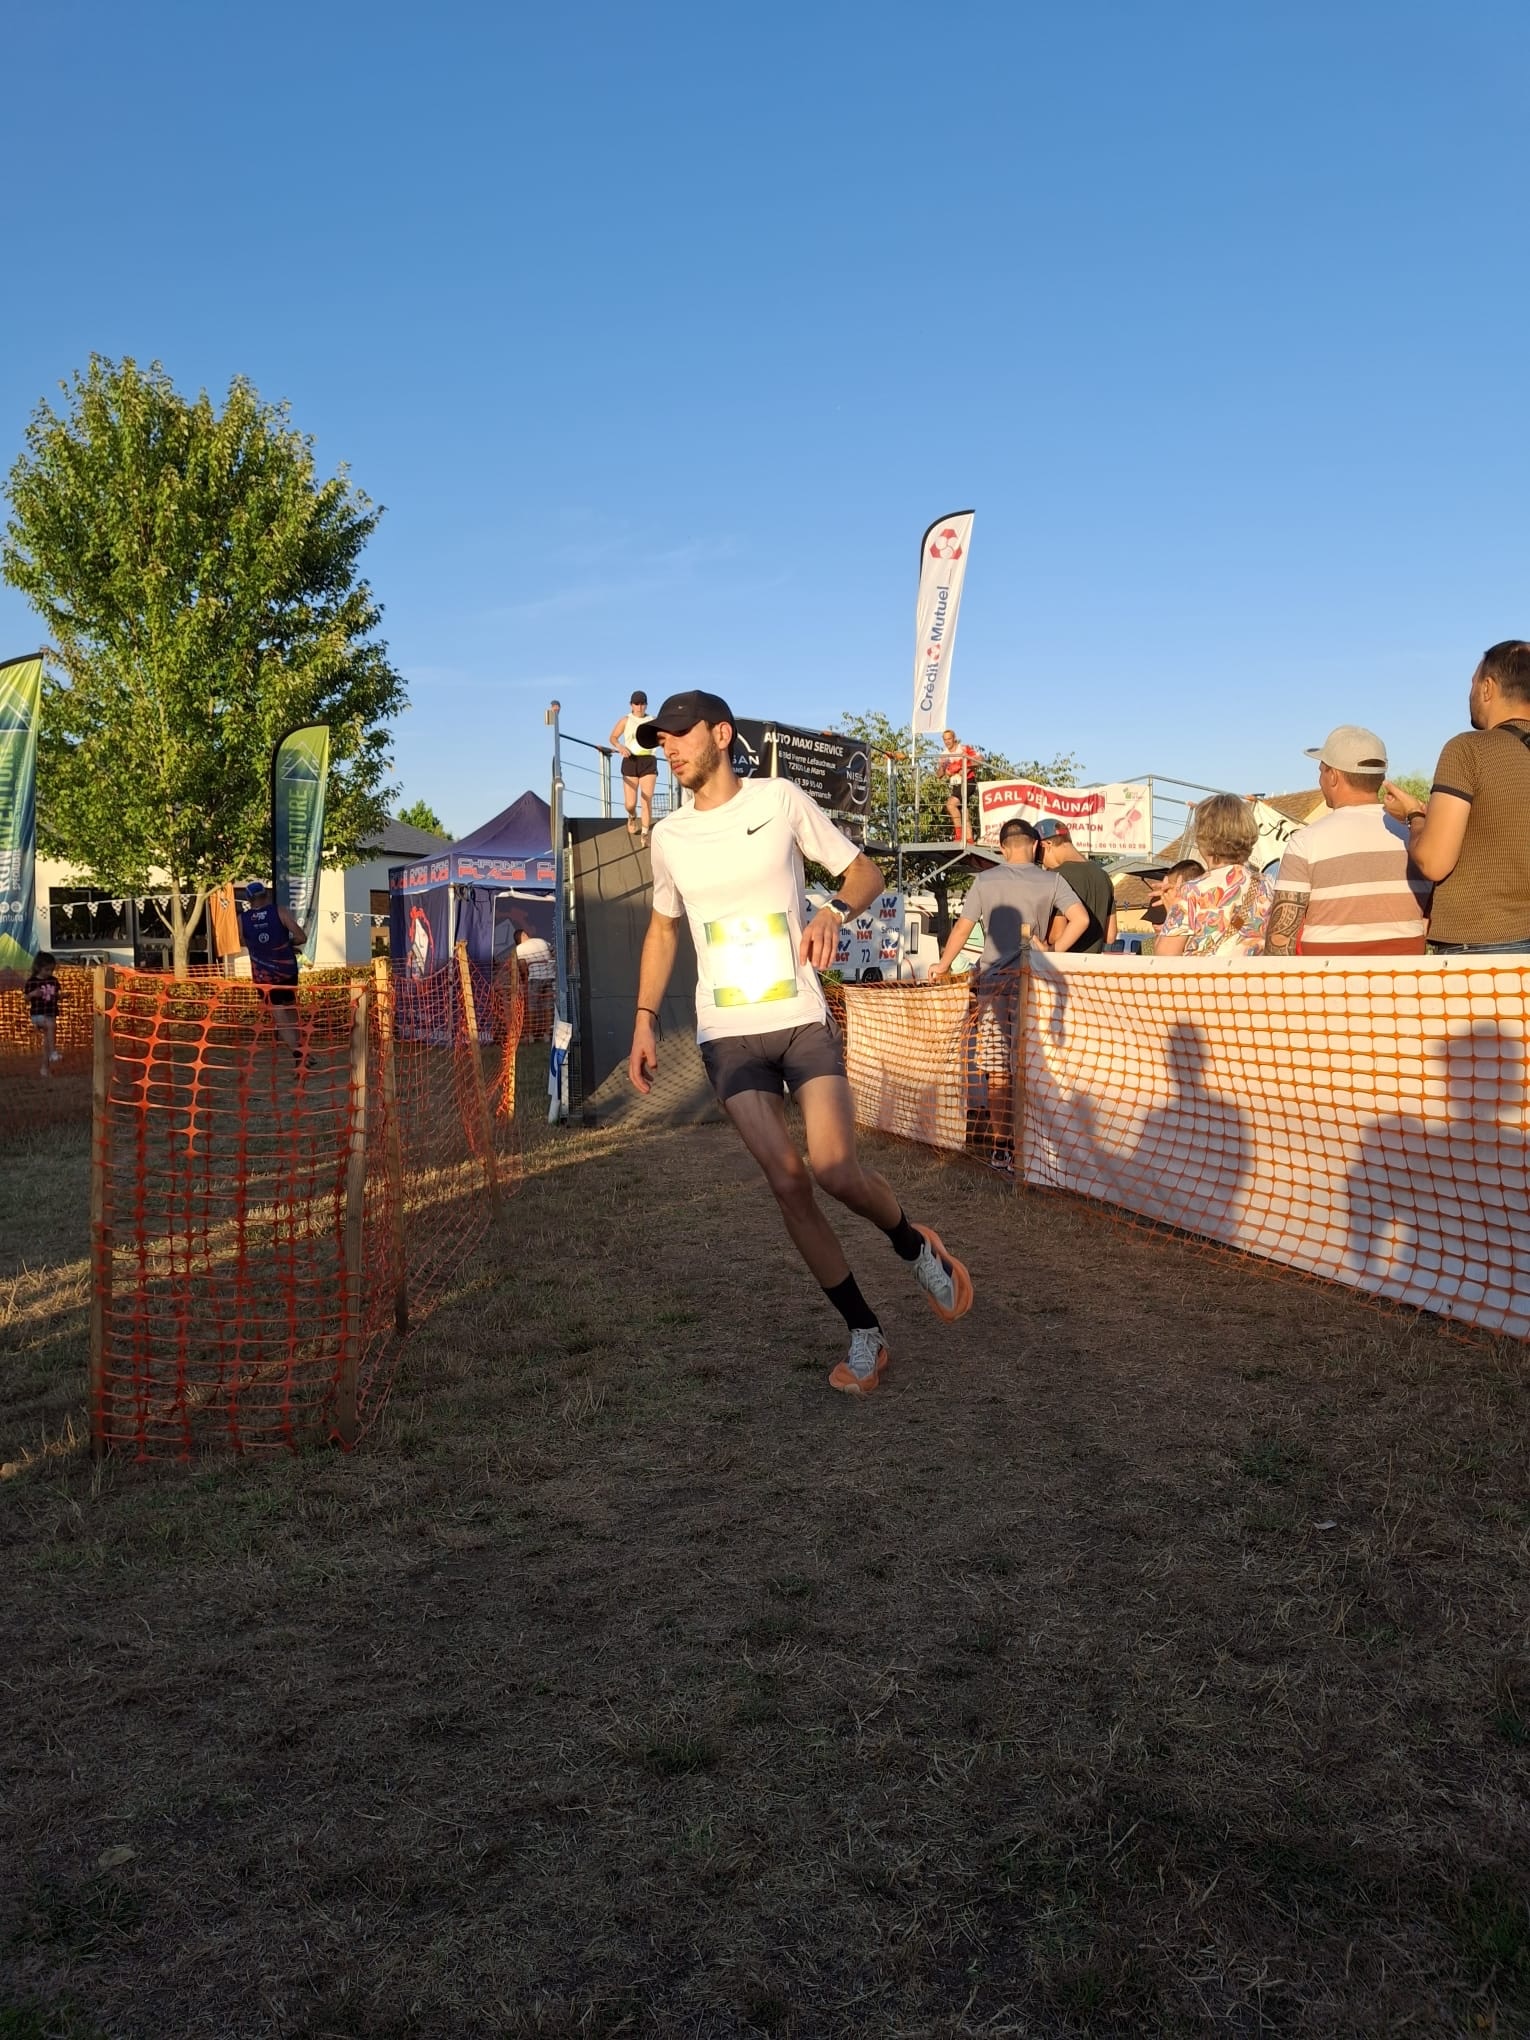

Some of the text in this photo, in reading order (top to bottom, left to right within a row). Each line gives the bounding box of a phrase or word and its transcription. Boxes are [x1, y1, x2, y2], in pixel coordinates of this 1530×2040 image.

[931, 586, 949, 641] Mutuel
[764, 731, 844, 757] AUTO MAXI SERVICE
[811, 767, 825, 776] Mans
[984, 790, 1095, 813] SARL DELAUNAY
[457, 858, 526, 869] CHRONO
[458, 867, 526, 881] PLACE
